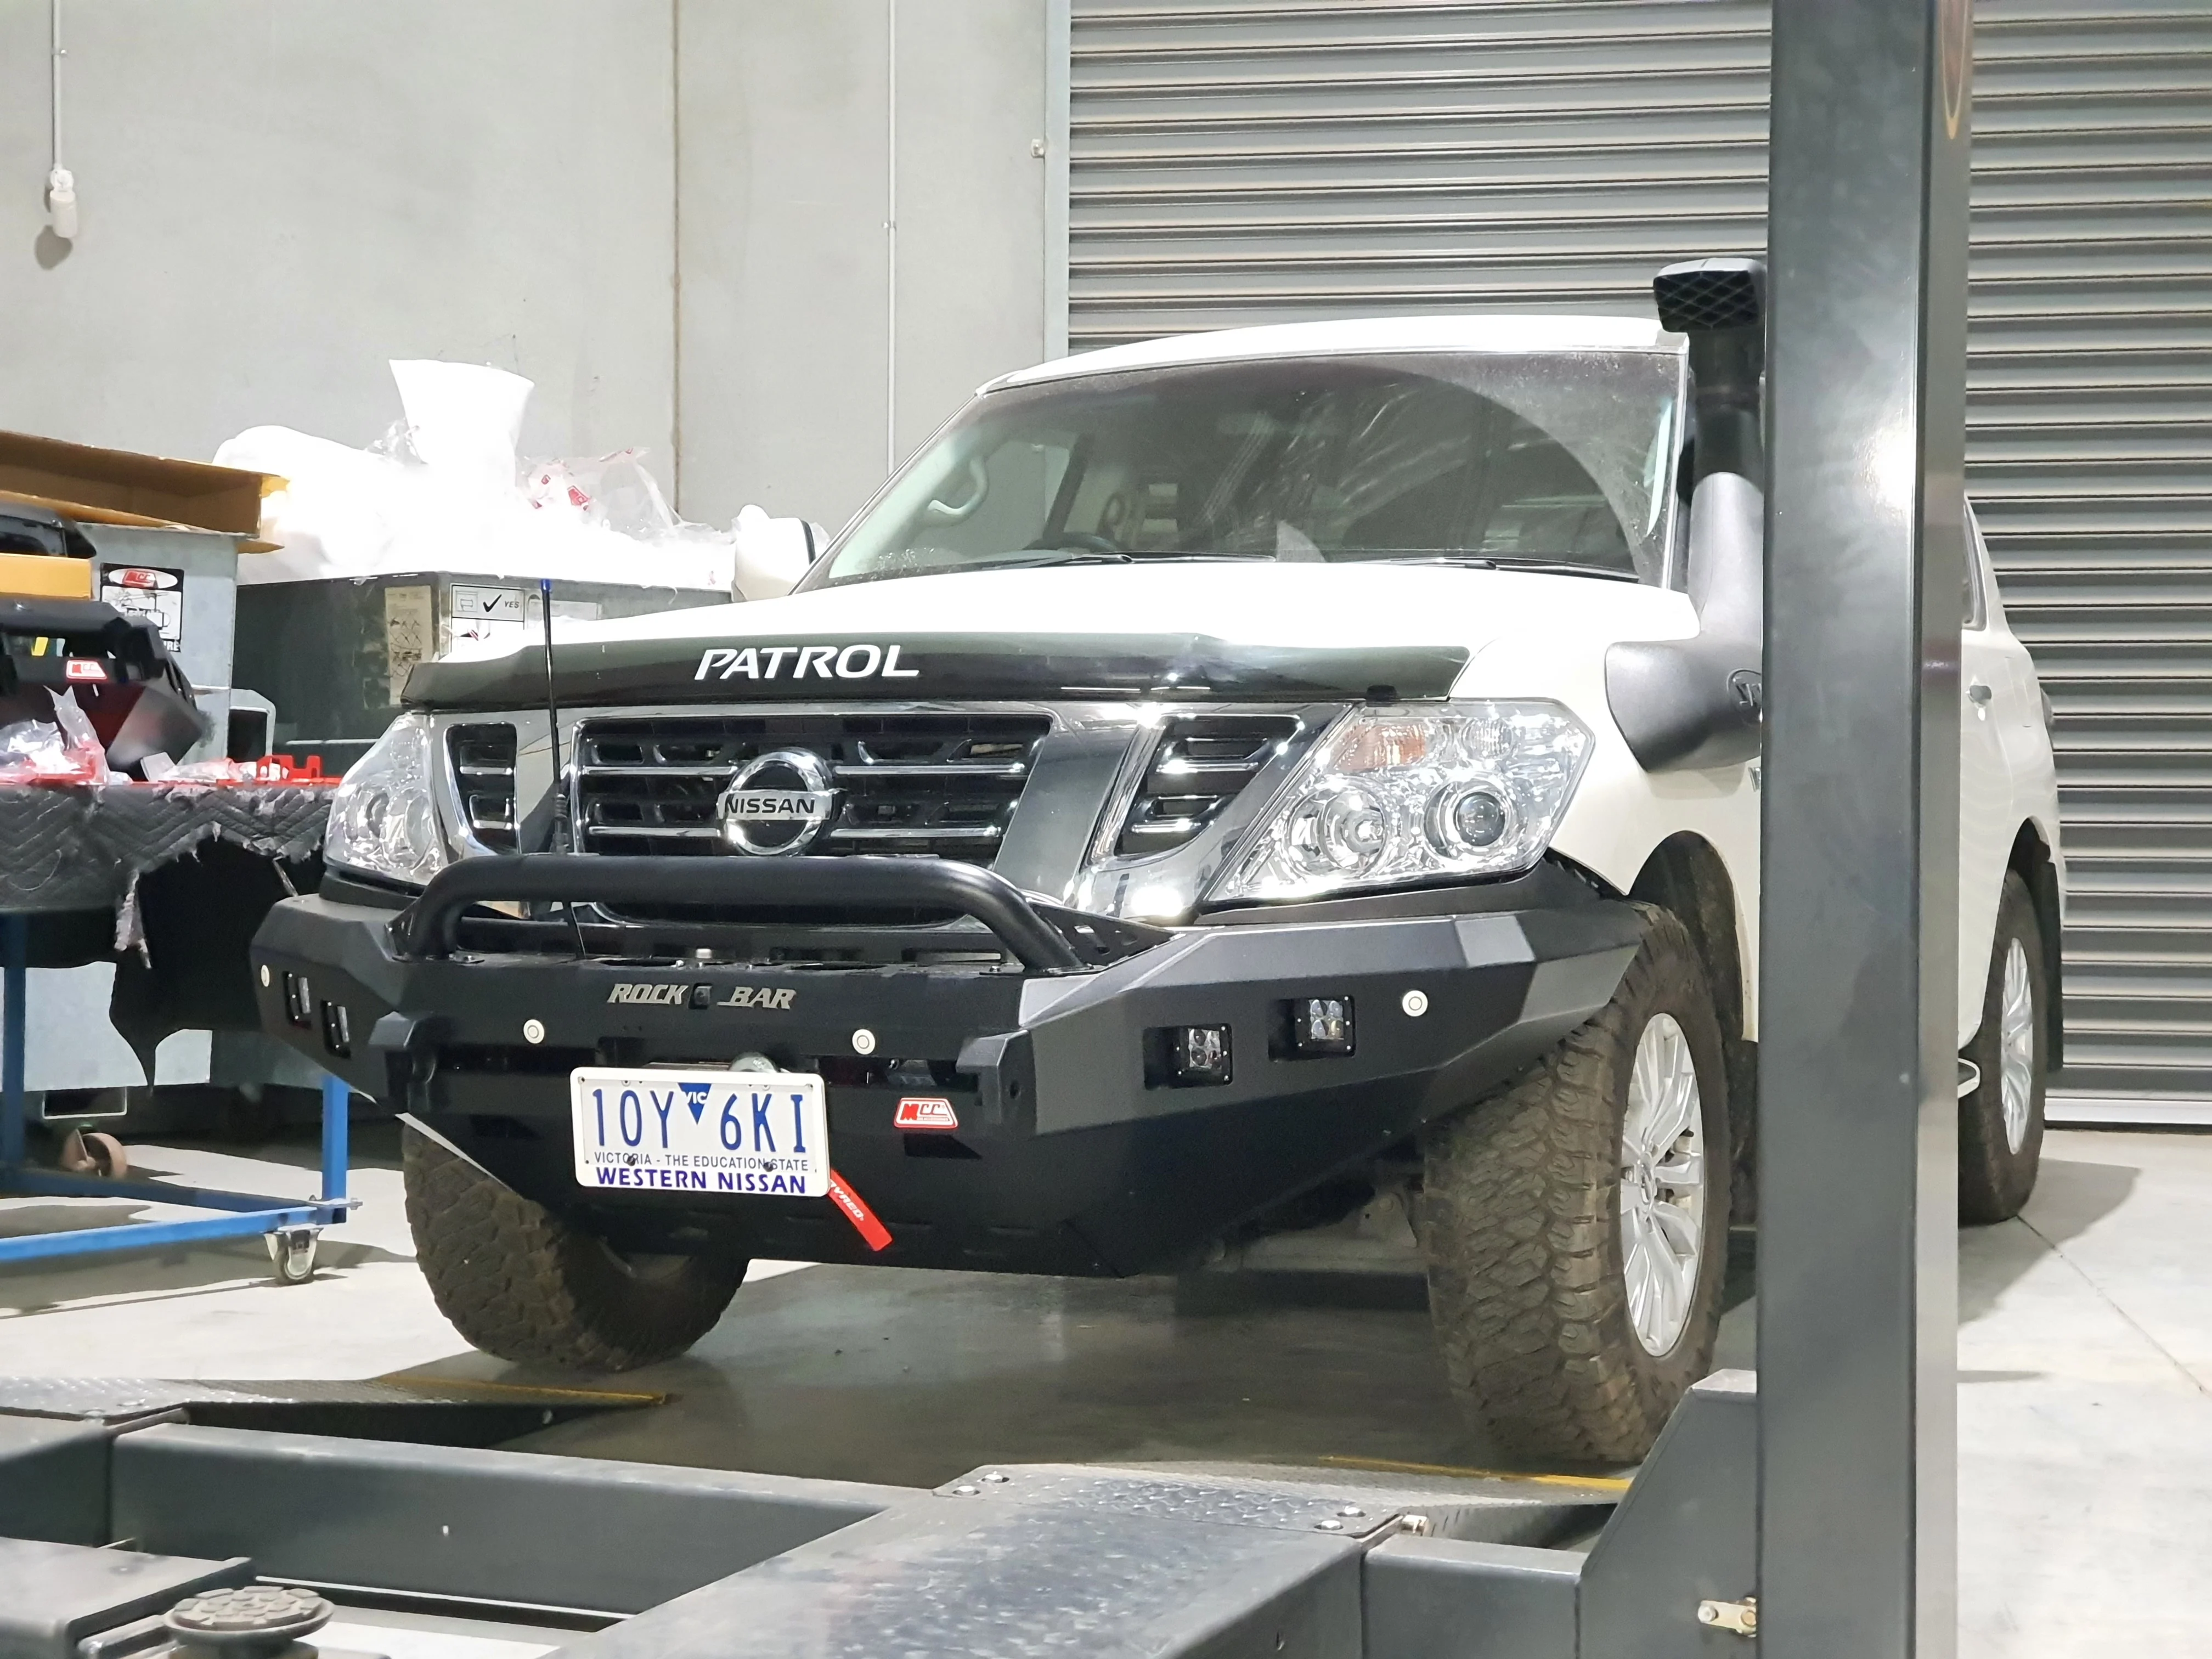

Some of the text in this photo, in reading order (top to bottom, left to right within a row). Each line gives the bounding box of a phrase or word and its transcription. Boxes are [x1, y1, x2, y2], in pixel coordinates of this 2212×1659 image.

[694, 645, 920, 680] PATROL
[725, 798, 815, 814] NISSAN
[607, 983, 797, 1010] ROCK BAR
[681, 1091, 708, 1104] VIC
[720, 1093, 806, 1153] 6KI
[595, 1152, 652, 1165] VICTORIA
[665, 1154, 689, 1166] THE
[693, 1155, 765, 1169] EDUCATION
[771, 1158, 809, 1171] STATE
[596, 1166, 805, 1194] WESTERN NISSAN
